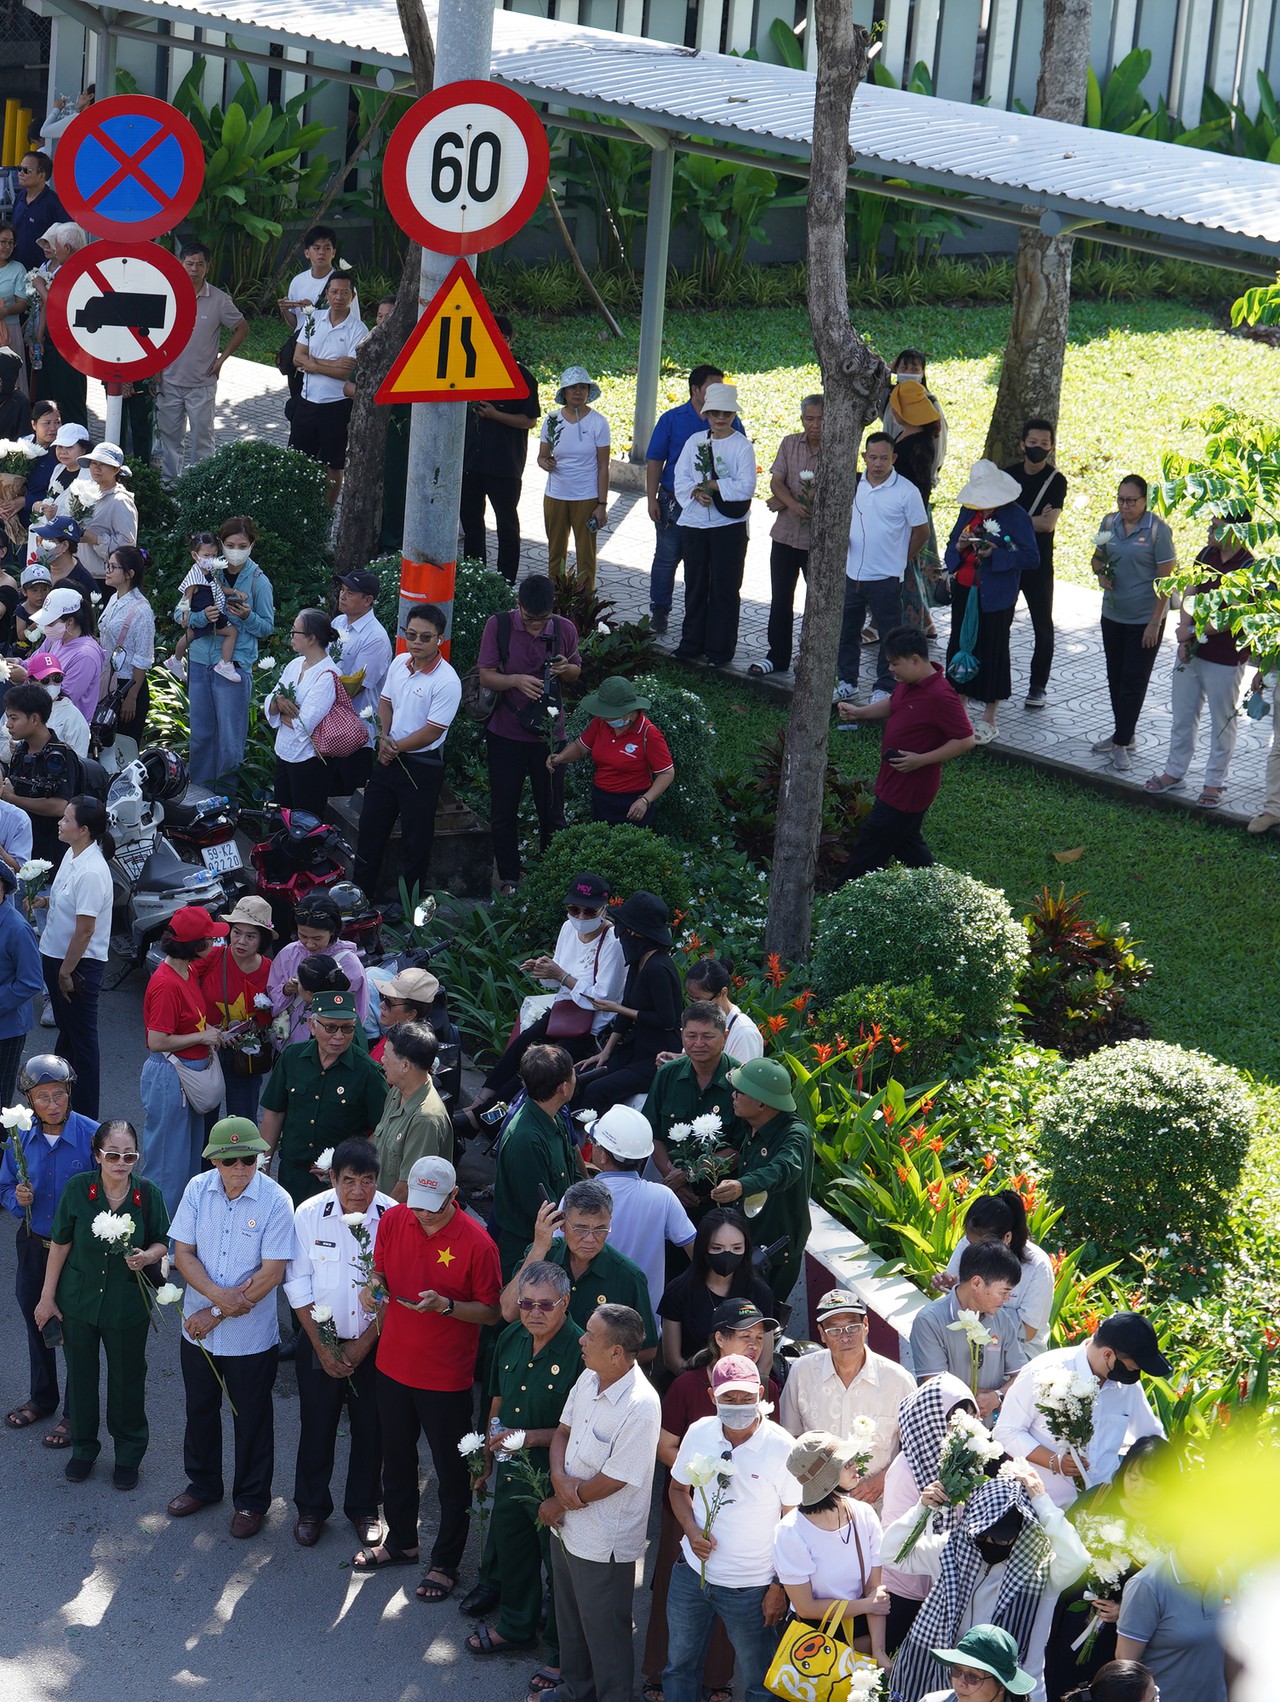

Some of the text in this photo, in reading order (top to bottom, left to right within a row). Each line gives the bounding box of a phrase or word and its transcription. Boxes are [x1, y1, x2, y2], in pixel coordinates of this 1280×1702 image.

[431, 131, 501, 203] 60
[44, 656, 53, 666] B
[207, 843, 234, 861] 59-K2
[208, 855, 240, 872] 022.20
